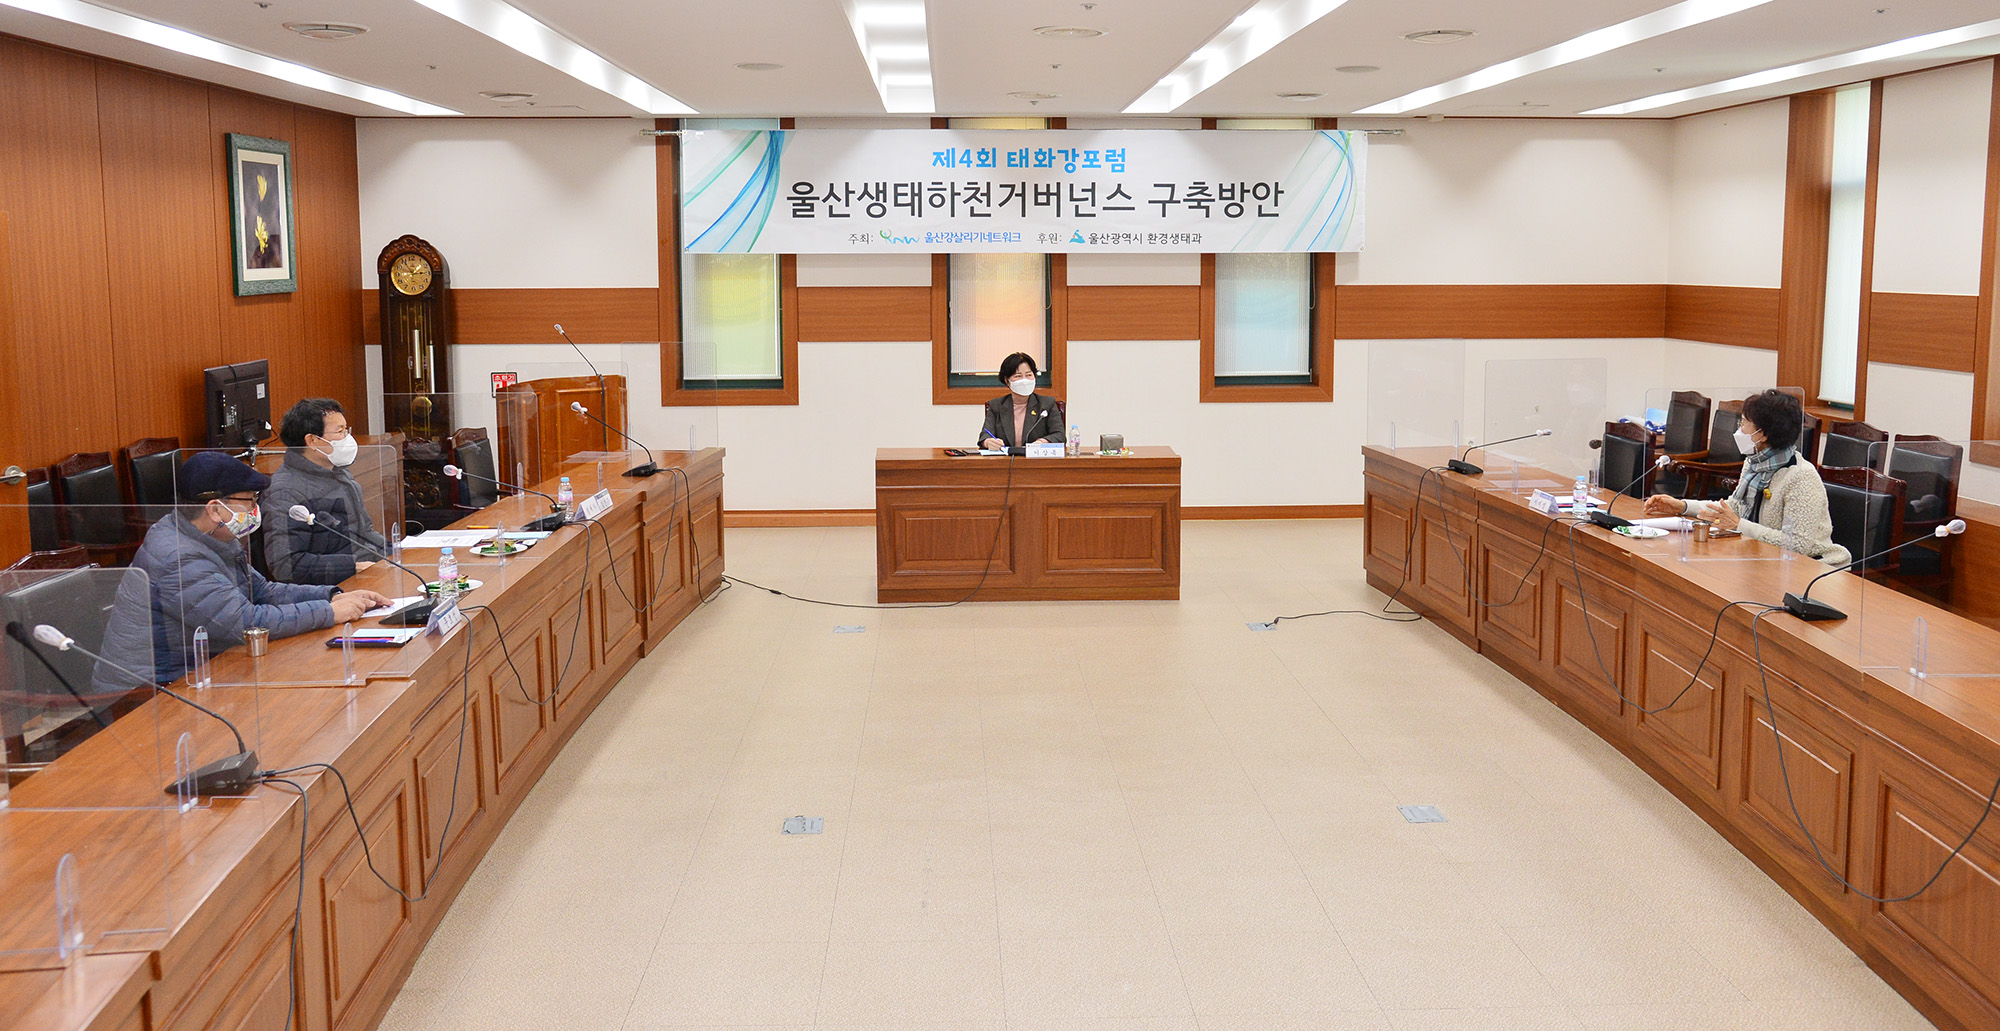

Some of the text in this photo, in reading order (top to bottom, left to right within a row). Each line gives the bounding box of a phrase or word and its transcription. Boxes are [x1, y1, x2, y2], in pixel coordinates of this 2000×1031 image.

[932, 147, 1126, 173] 제4회 태화강포럼
[786, 181, 1285, 218] 울산생태하천거버넌스 구축방안
[848, 233, 874, 245] 주최:
[925, 231, 1022, 244] 울산강살리기네트워크
[1037, 232, 1203, 245] 후원: 울산광역시 환경생태과
